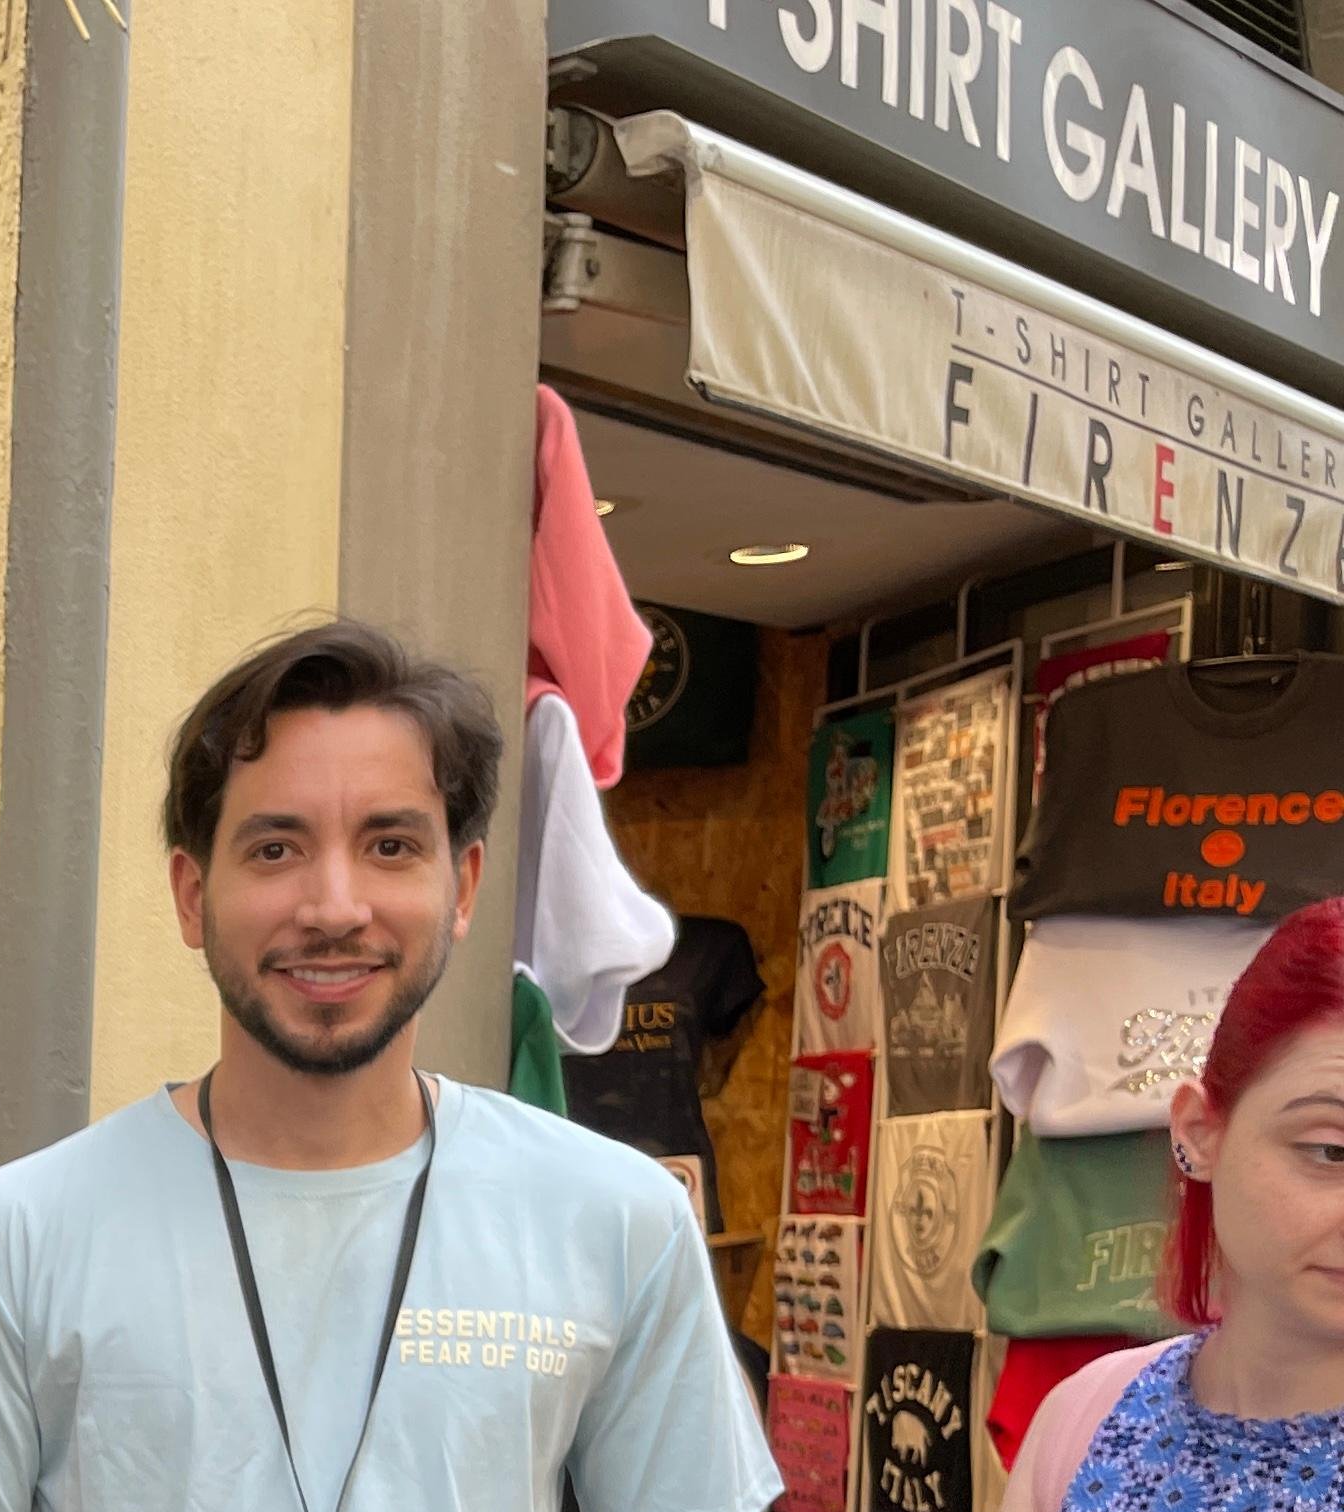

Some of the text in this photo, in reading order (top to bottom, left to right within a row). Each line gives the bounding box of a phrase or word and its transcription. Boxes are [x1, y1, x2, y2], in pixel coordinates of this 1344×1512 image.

[1042, 46, 1340, 317] GALLERY
[952, 287, 1150, 417] T-SHIRT
[1113, 784, 1344, 827] Florence
[1163, 871, 1266, 916] Italy
[396, 1308, 577, 1348] ESSENTIALS
[399, 1340, 569, 1376] FEAR OF GOD
